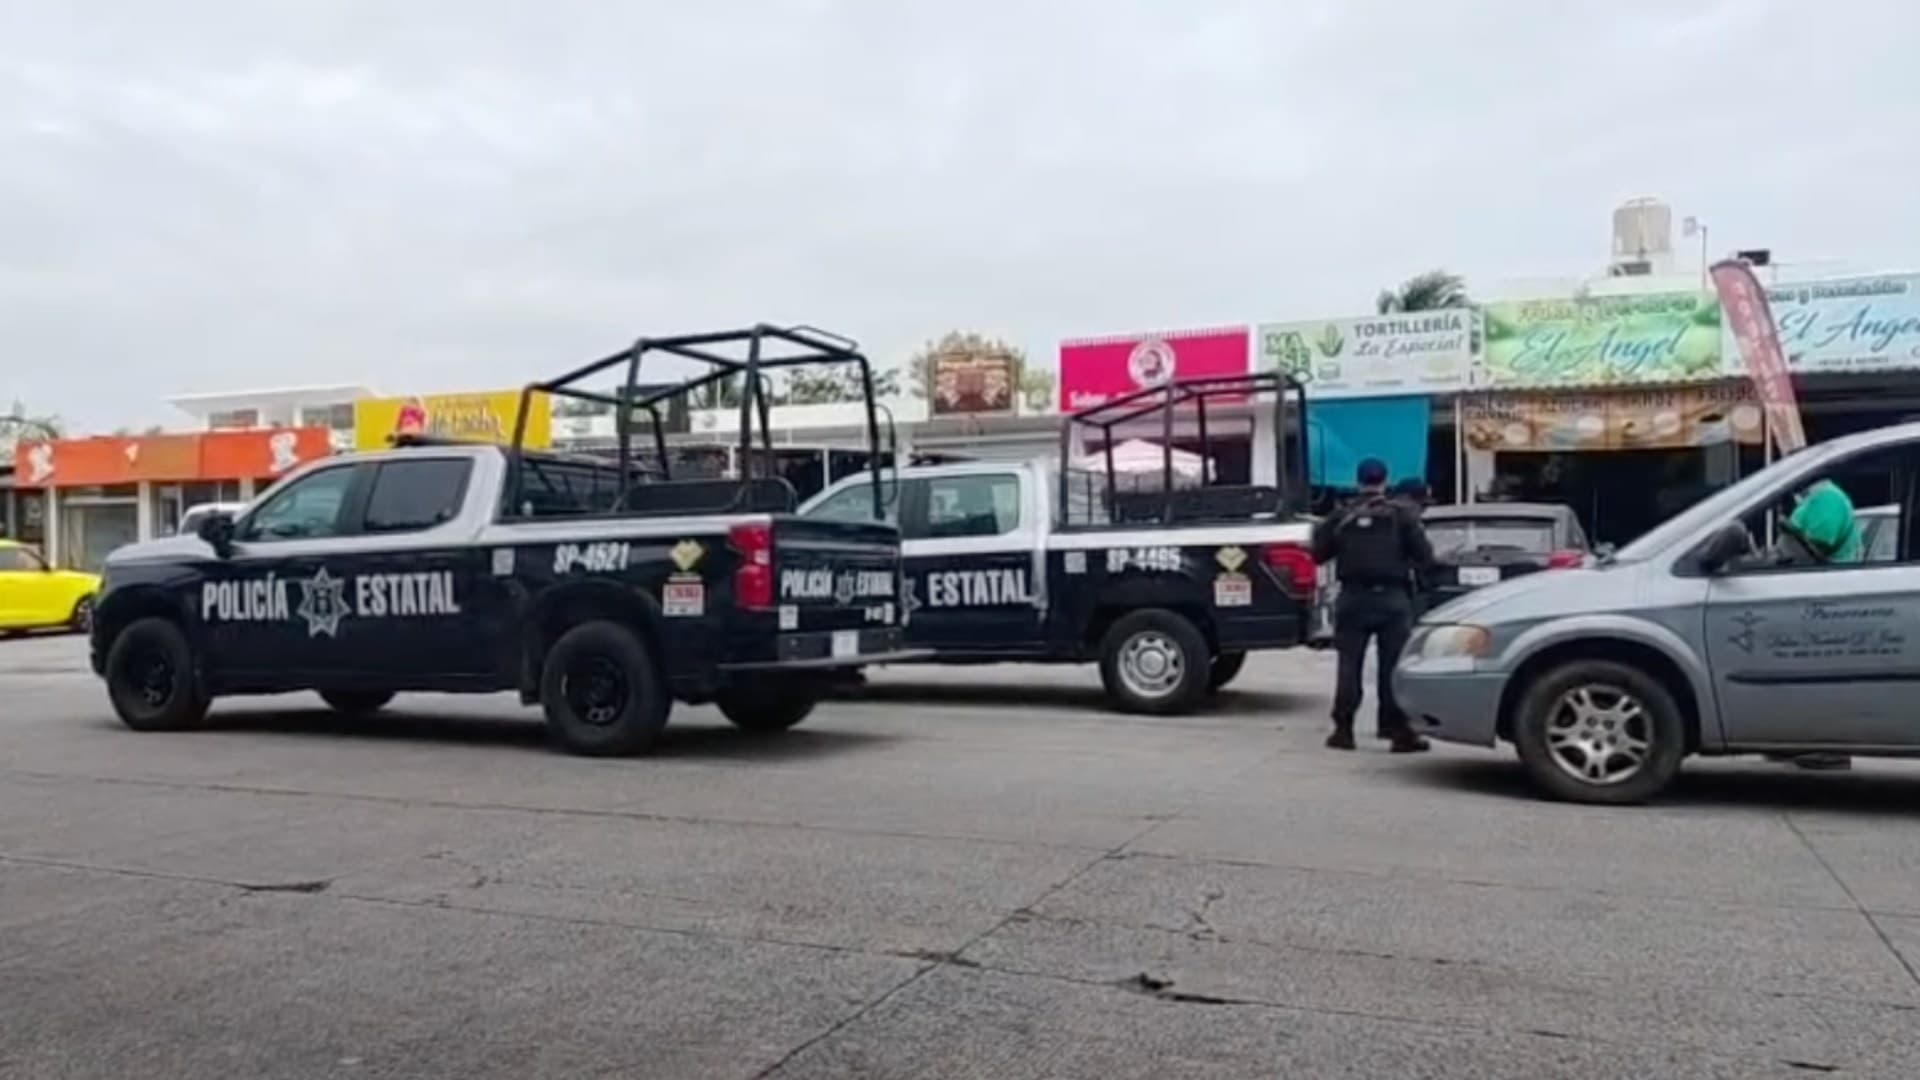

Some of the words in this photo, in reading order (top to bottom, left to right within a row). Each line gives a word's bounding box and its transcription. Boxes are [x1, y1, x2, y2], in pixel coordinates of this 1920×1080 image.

[1354, 315, 1462, 338] TORTILLERÍA
[1814, 304, 1920, 351] Ange
[1383, 335, 1464, 359] Especial
[553, 541, 630, 574] SP-4521
[202, 571, 289, 620] POLICÍA
[356, 571, 462, 617] ESTATAL
[928, 569, 1034, 607] ESTATAL
